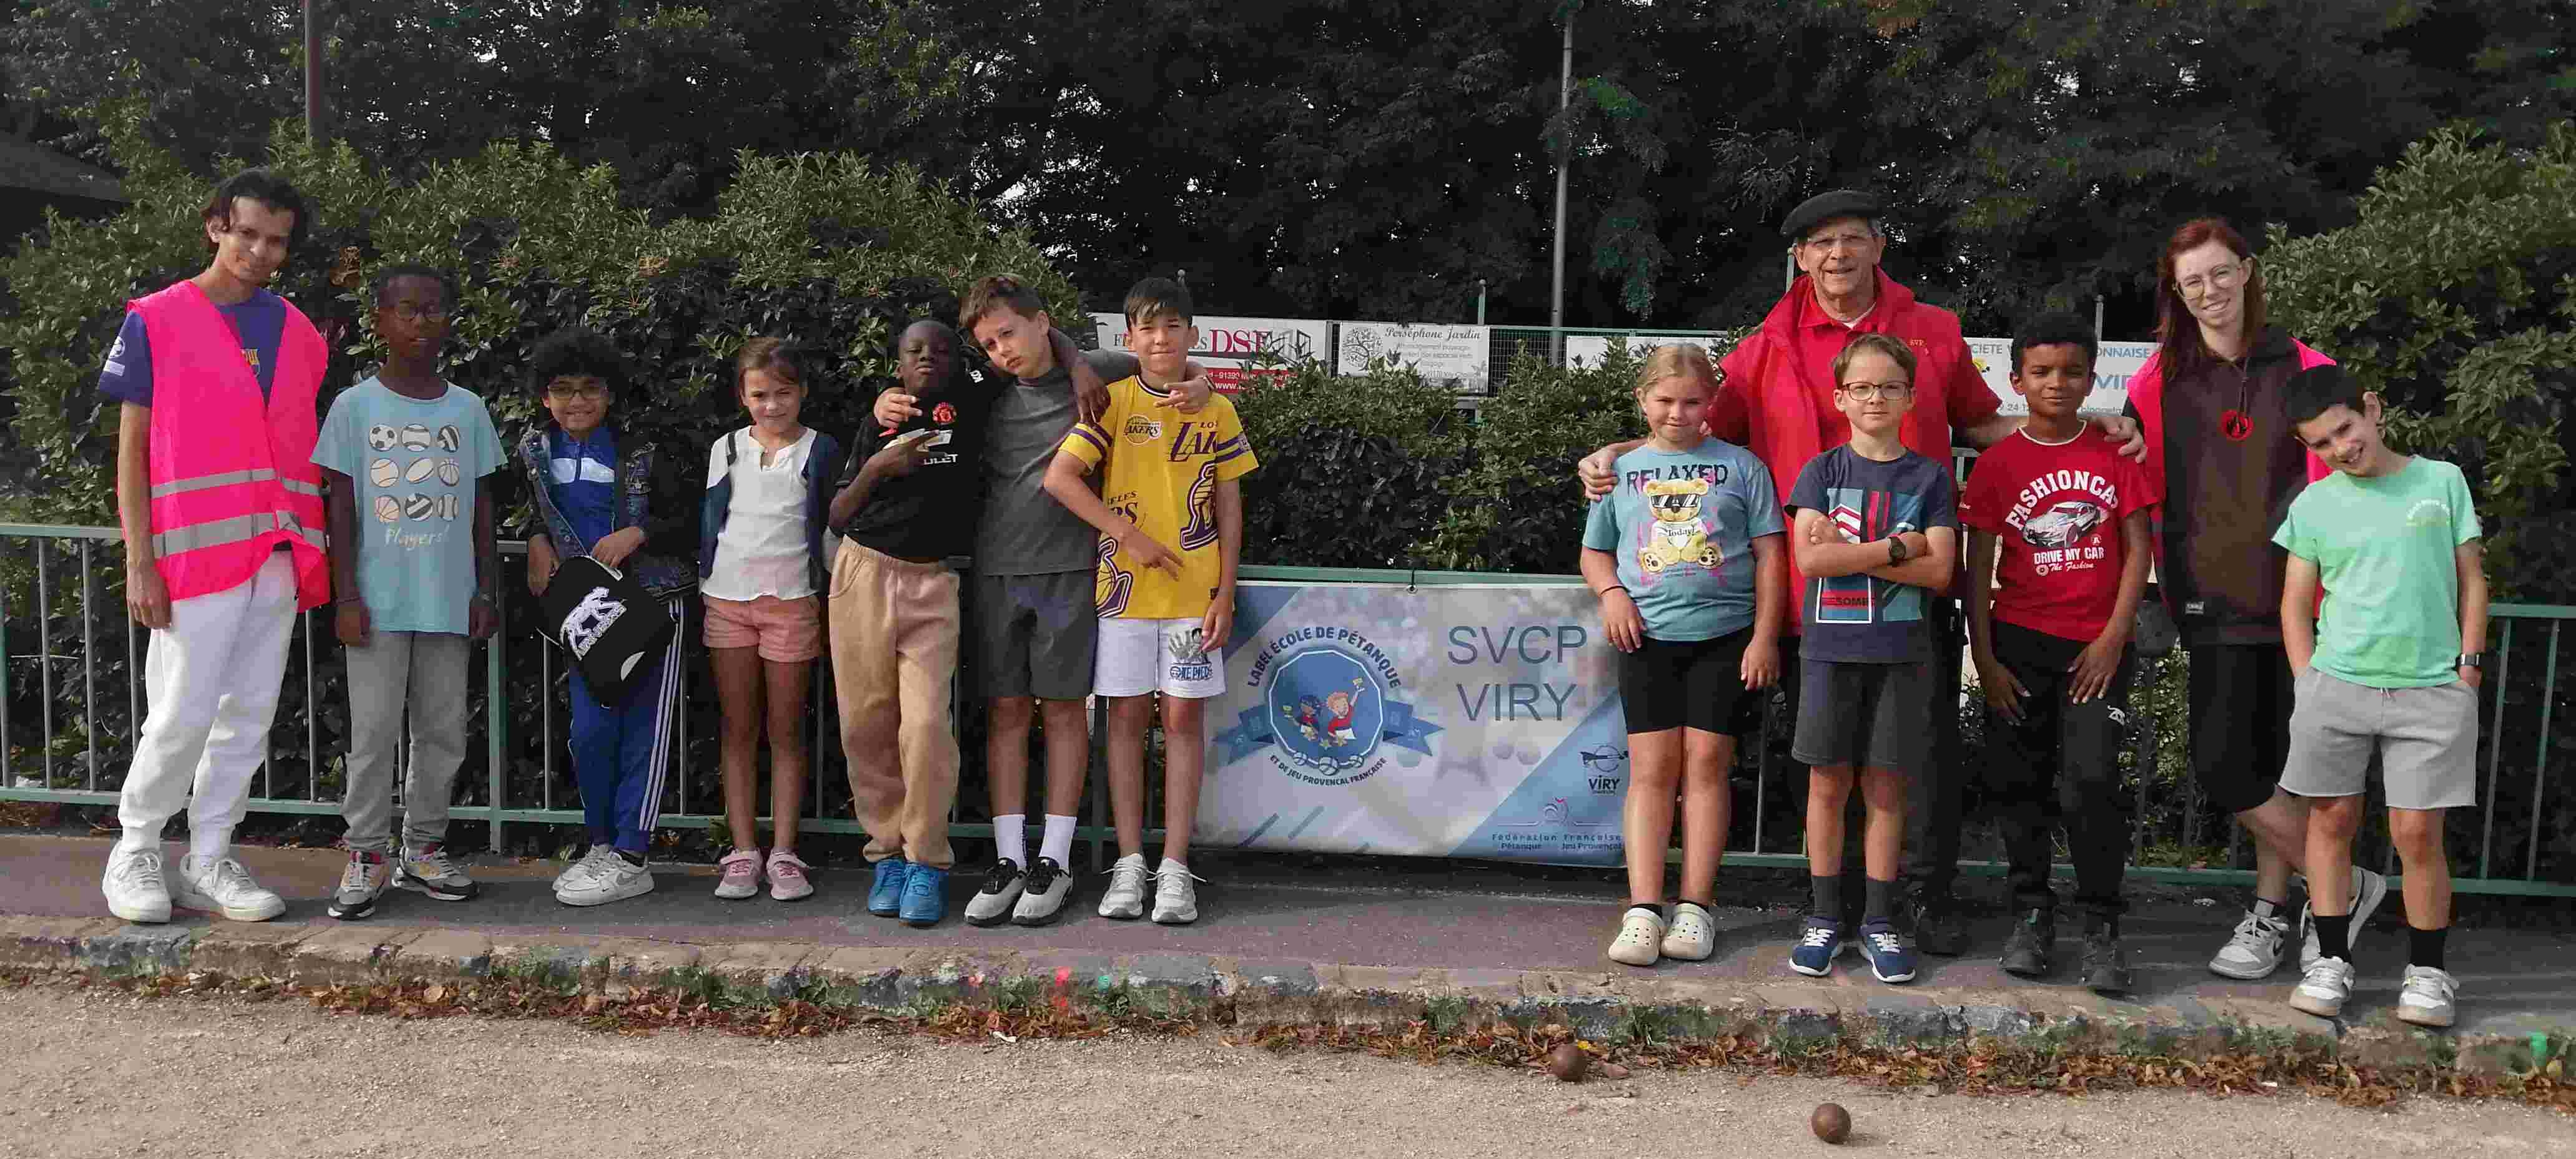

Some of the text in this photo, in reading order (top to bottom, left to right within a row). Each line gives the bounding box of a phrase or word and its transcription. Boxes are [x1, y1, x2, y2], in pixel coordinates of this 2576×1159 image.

[1447, 326, 1482, 341] Jardin
[1124, 424, 1161, 438] LAKERS
[1626, 464, 1729, 496] RELAXED
[2034, 547, 2104, 564] DRIVE MY CAR
[2049, 560, 2094, 572] The Fashion
[1247, 627, 1402, 688] LABEL ÉCOLE DE PÉTANQUE
[1448, 625, 1588, 665] SVCP
[1456, 683, 1578, 721] VIRY
[1269, 754, 1279, 765] ET
[1278, 762, 1289, 773] DE
[1286, 768, 1302, 780] JEU
